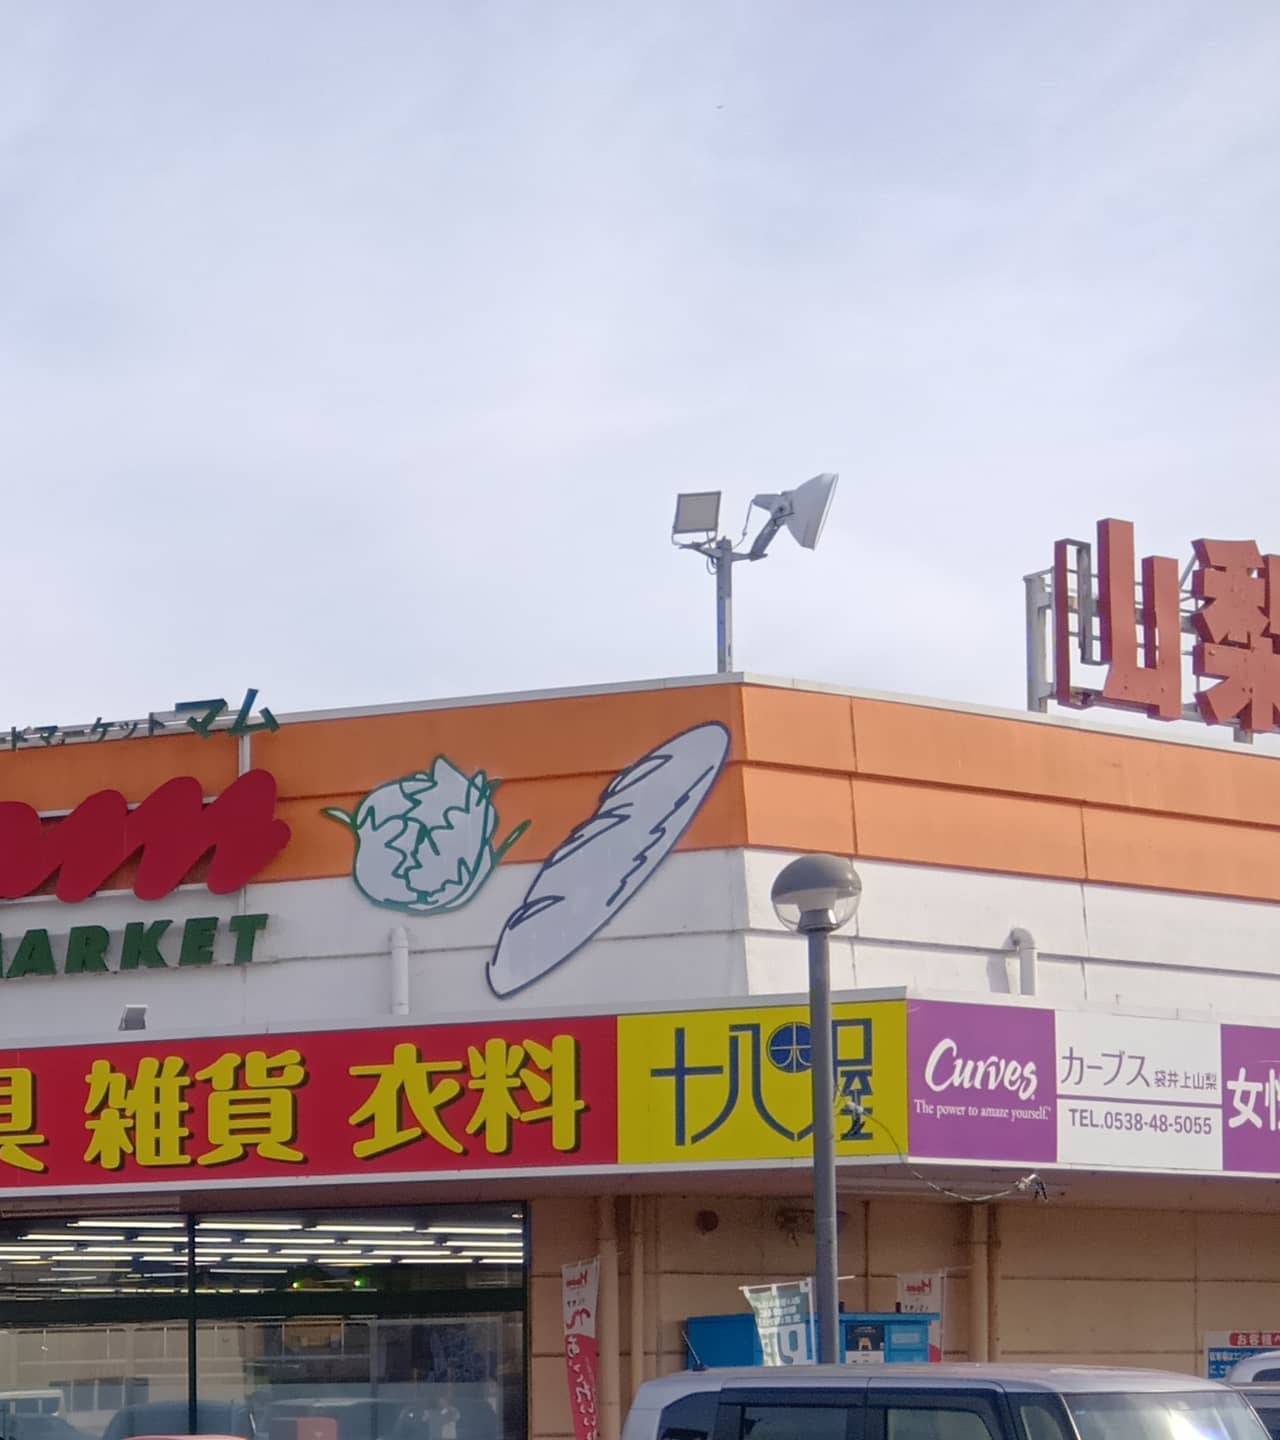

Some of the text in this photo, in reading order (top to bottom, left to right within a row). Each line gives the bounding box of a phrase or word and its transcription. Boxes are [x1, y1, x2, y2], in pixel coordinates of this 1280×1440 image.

[175, 688, 281, 740] マム
[924, 1038, 1039, 1100] Curves
[1060, 1047, 1217, 1091] カーブス 袋井上山梨
[84, 1049, 310, 1170] 雑貨
[348, 1034, 589, 1159] 衣料
[913, 1099, 934, 1114] The
[936, 1104, 966, 1120] power
[968, 1105, 978, 1116] to
[980, 1107, 1009, 1118] amaze
[1067, 1108, 1212, 1135] TEL.0538-48-5055
